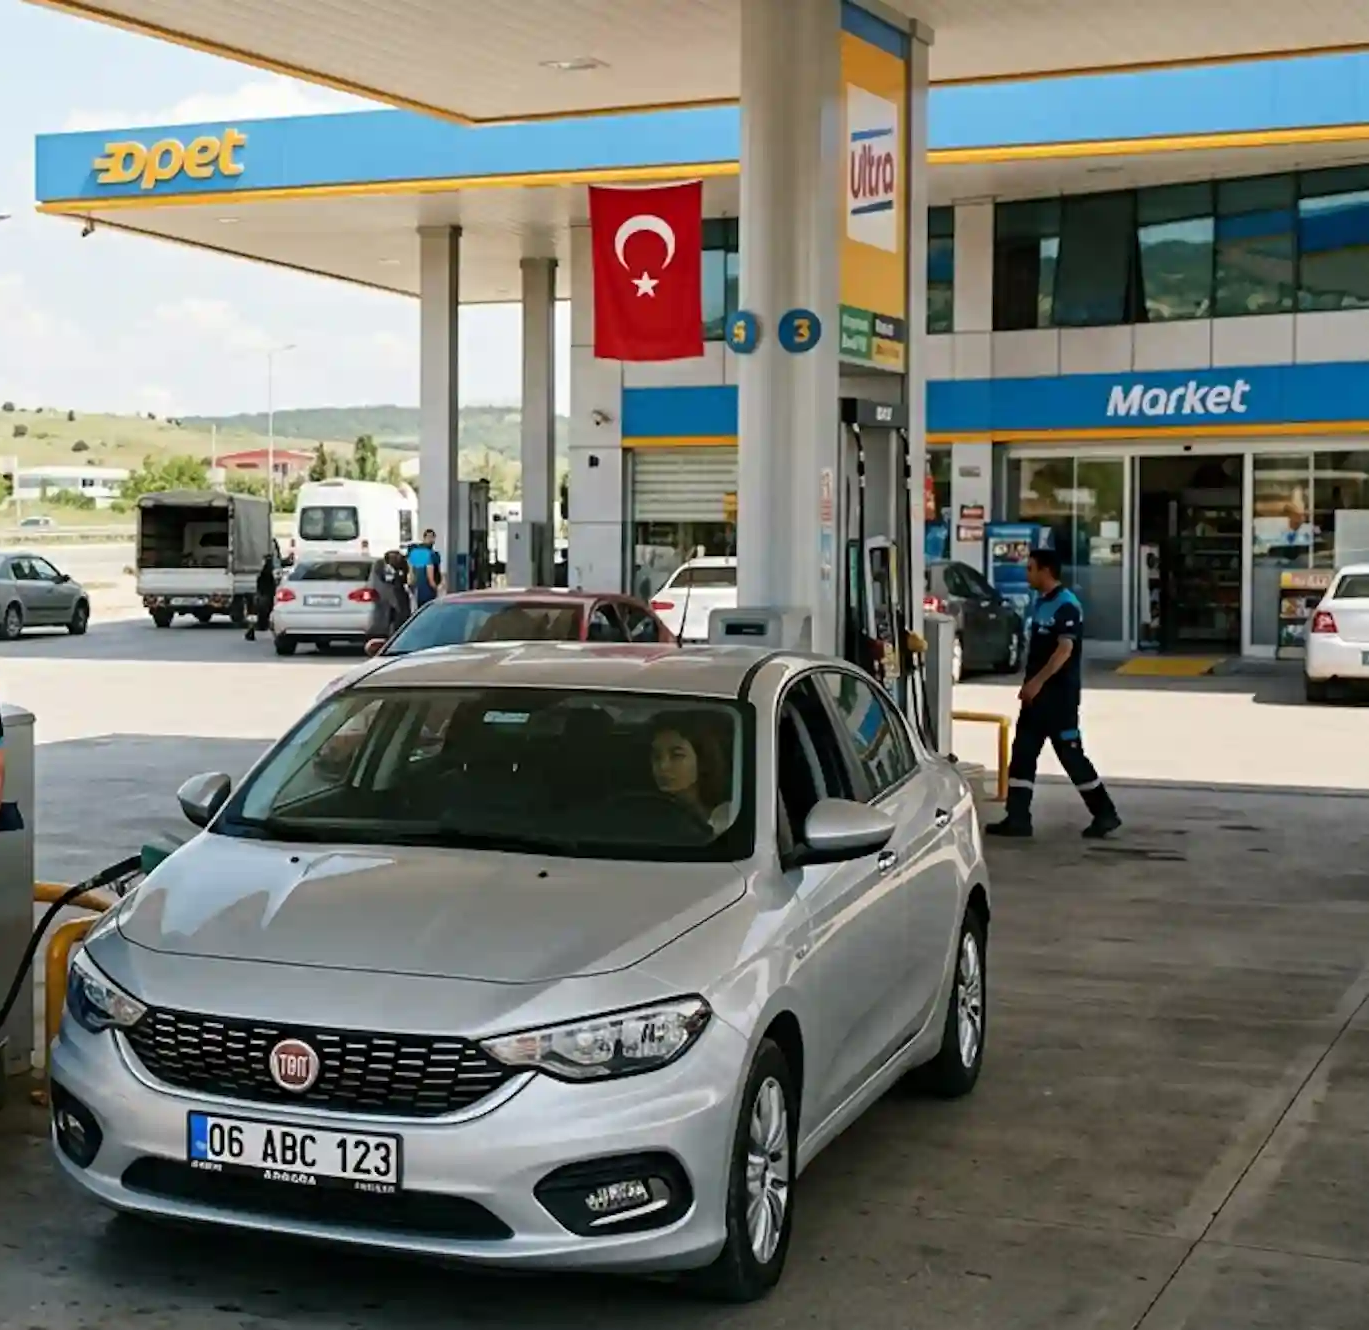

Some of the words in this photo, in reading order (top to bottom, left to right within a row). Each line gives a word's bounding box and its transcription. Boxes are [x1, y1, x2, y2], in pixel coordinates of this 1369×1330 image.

[793, 318, 811, 343] 3
[1106, 378, 1251, 416] Market
[209, 1123, 244, 1158] 06
[262, 1129, 317, 1168] ABC
[336, 1138, 392, 1177] 123
